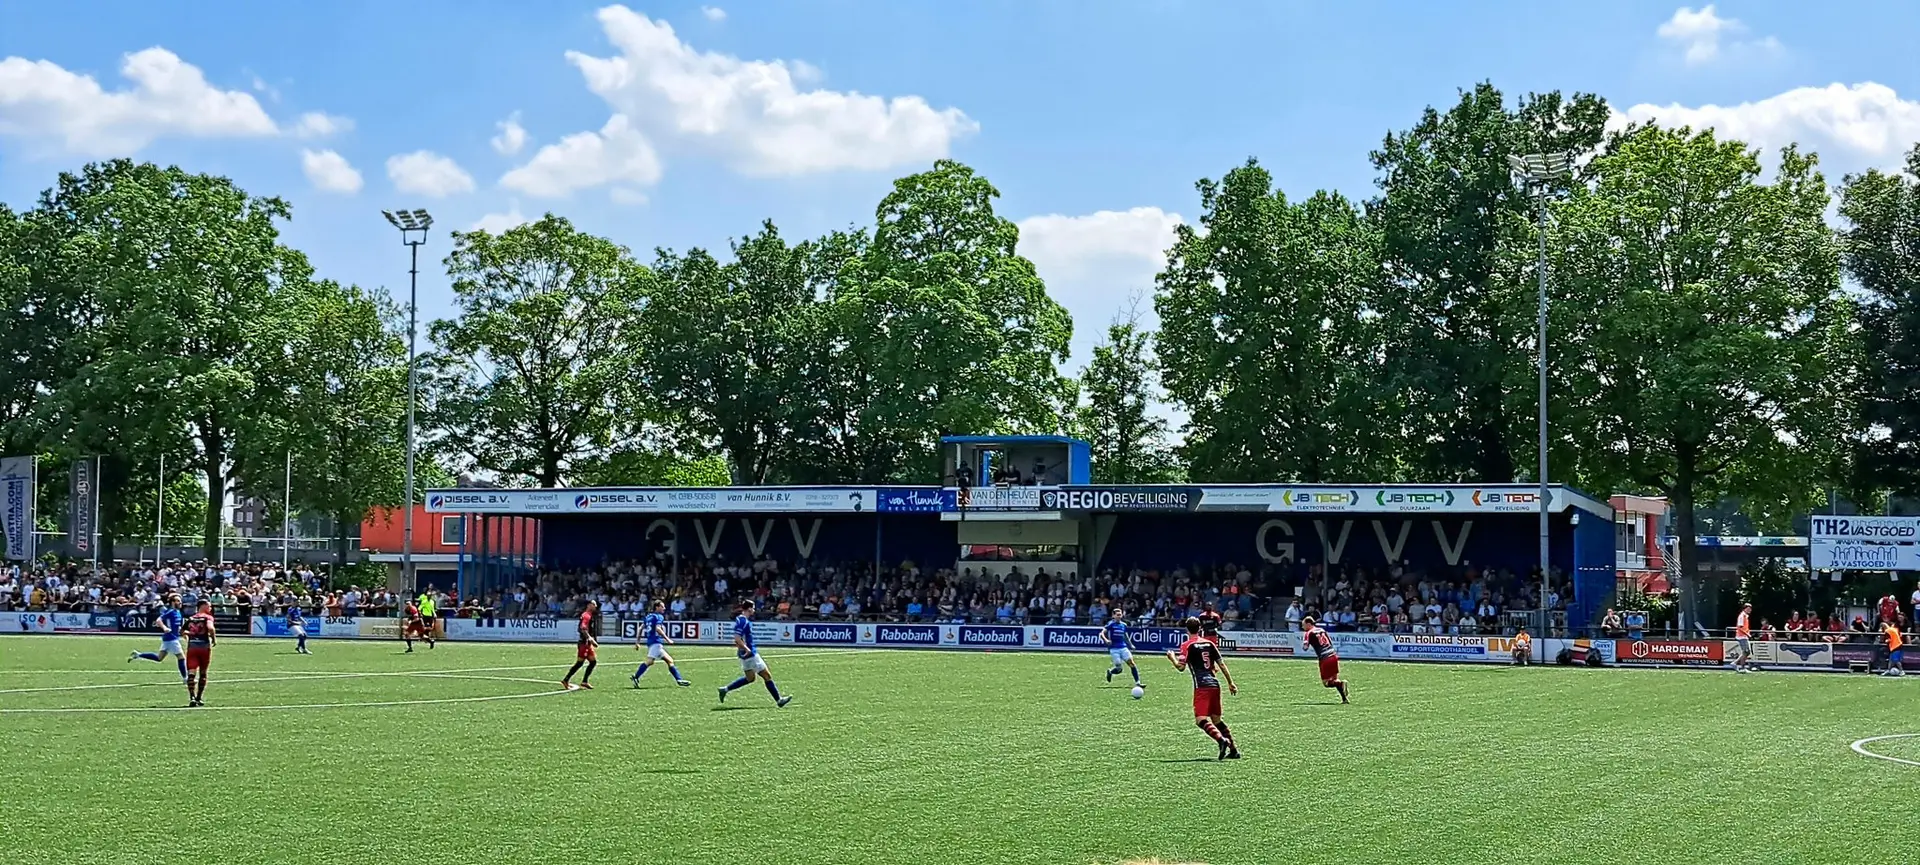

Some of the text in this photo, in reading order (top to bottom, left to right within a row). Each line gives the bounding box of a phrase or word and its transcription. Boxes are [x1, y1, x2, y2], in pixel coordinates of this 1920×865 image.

[744, 493, 774, 501] Hunnik
[776, 493, 792, 501] B.V.
[888, 490, 944, 506] van Hunnik
[971, 491, 1039, 500] VAN DEN HEUVEL
[1056, 491, 1188, 509] REGIO BEVEILIGING
[1293, 493, 1310, 502] JB
[1386, 493, 1404, 502] JB
[1483, 494, 1500, 503] JB
[1813, 519, 1915, 537] TH2 VASTGOED
[510, 620, 559, 629] VAN GENT
[800, 628, 852, 640] Rabobank
[881, 629, 934, 641] Rabobank
[964, 630, 1019, 642] Rabobank
[1125, 629, 1162, 643] vallei
[1394, 635, 1484, 645] Van Holland Sport
[1651, 645, 1709, 653] HARDEMAN
[1201, 651, 1211, 669] 5
